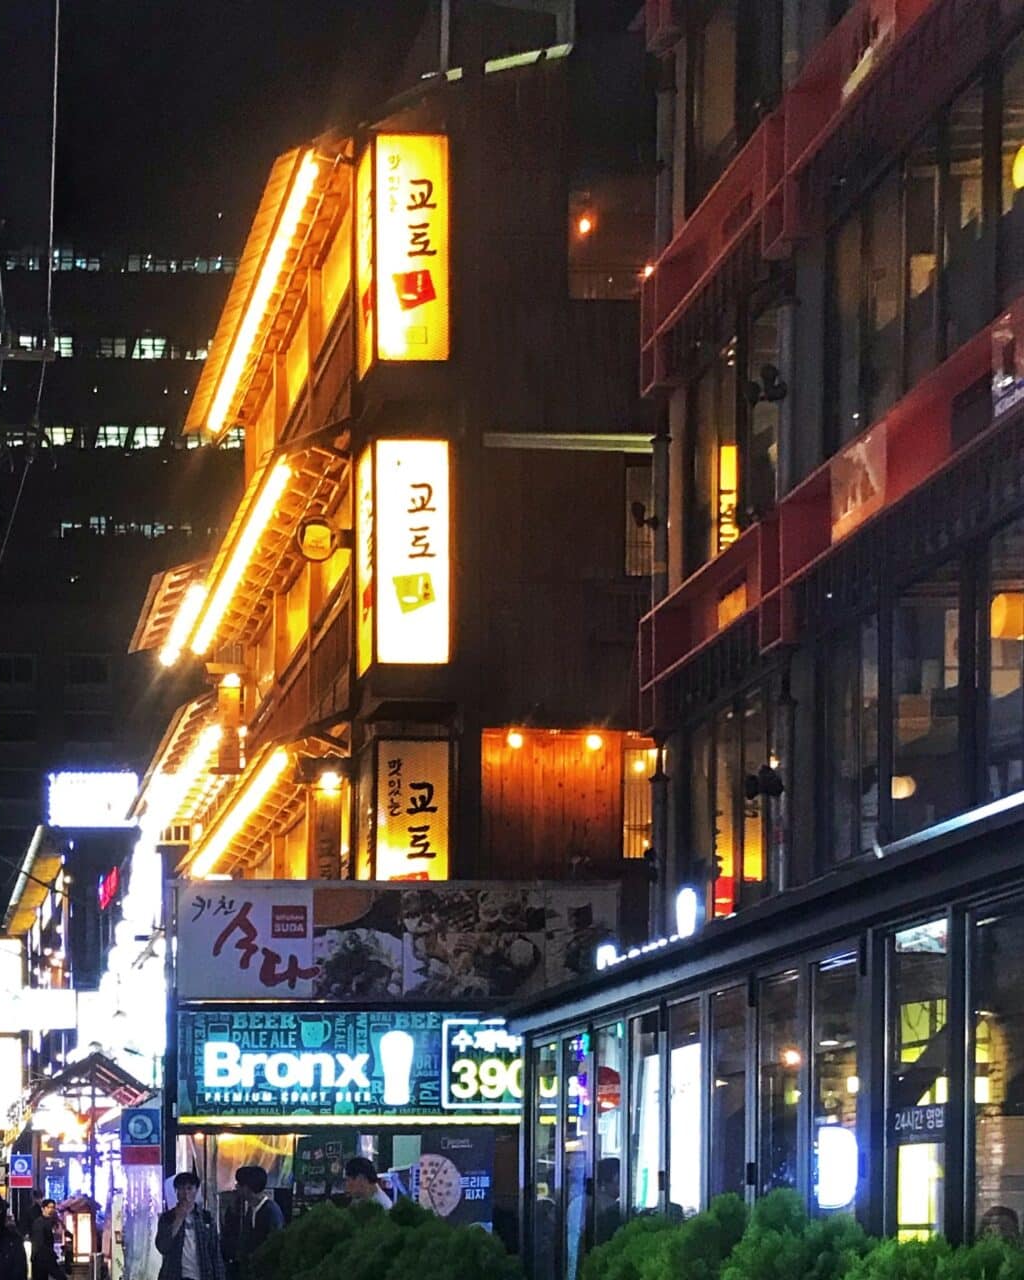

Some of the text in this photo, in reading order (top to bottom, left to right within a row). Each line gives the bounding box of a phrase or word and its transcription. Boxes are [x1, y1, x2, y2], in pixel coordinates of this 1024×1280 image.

[387, 758, 403, 817] 맛있는
[191, 895, 236, 922] 키친
[274, 924, 304, 933] SUDA
[212, 901, 321, 990] 수다
[232, 1013, 297, 1029] BEER
[395, 1013, 443, 1029] BEE
[232, 1031, 297, 1048] PALE ALE
[203, 1041, 371, 1088] Bronx
[205, 1092, 371, 1102] PREMIUM CRAFT BEER
[419, 1079, 440, 1106] IPA
[894, 1107, 945, 1130] 24시간 영업
